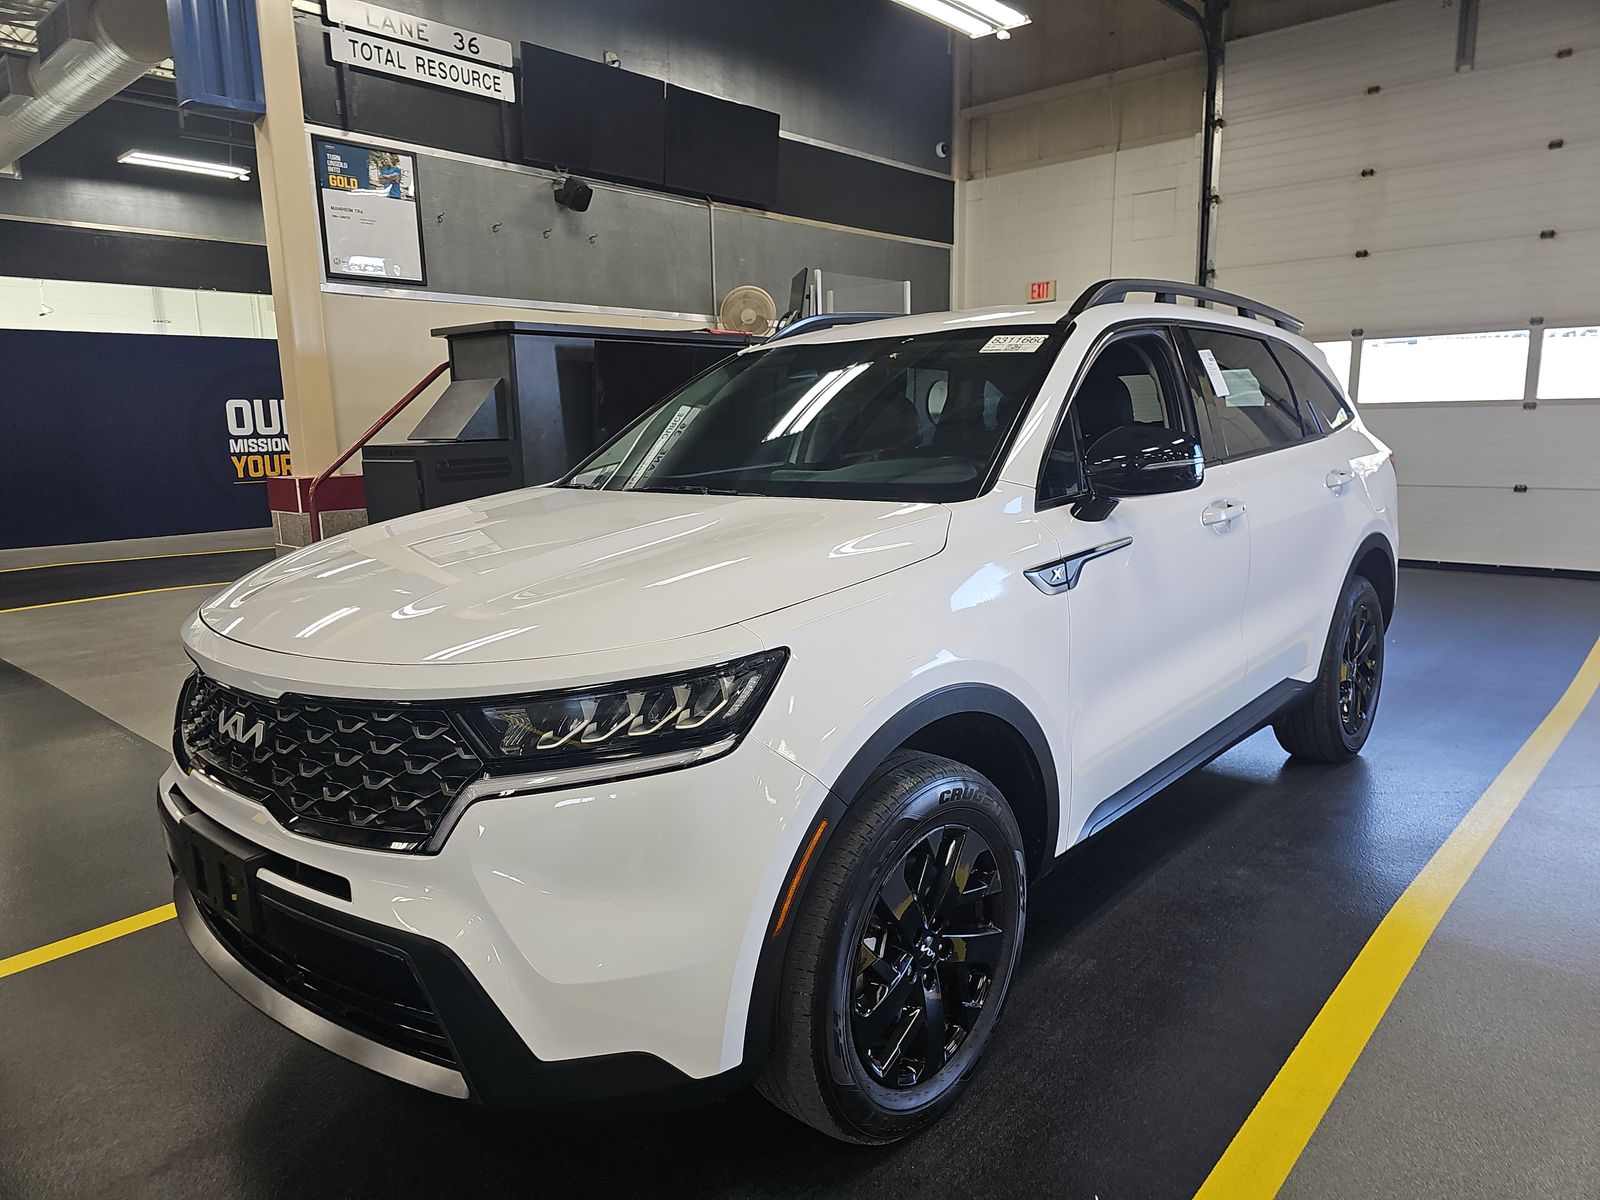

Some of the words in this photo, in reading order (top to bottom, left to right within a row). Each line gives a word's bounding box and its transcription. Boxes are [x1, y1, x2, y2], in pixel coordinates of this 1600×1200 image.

[366, 8, 429, 42] LANE
[453, 32, 480, 55] 36
[348, 38, 407, 70] TOTAL
[415, 55, 502, 93] RESOURCE
[328, 174, 358, 190] GOLD
[1031, 281, 1050, 300] EXIT
[229, 437, 291, 453] MISSION
[230, 454, 292, 478] YOUR
